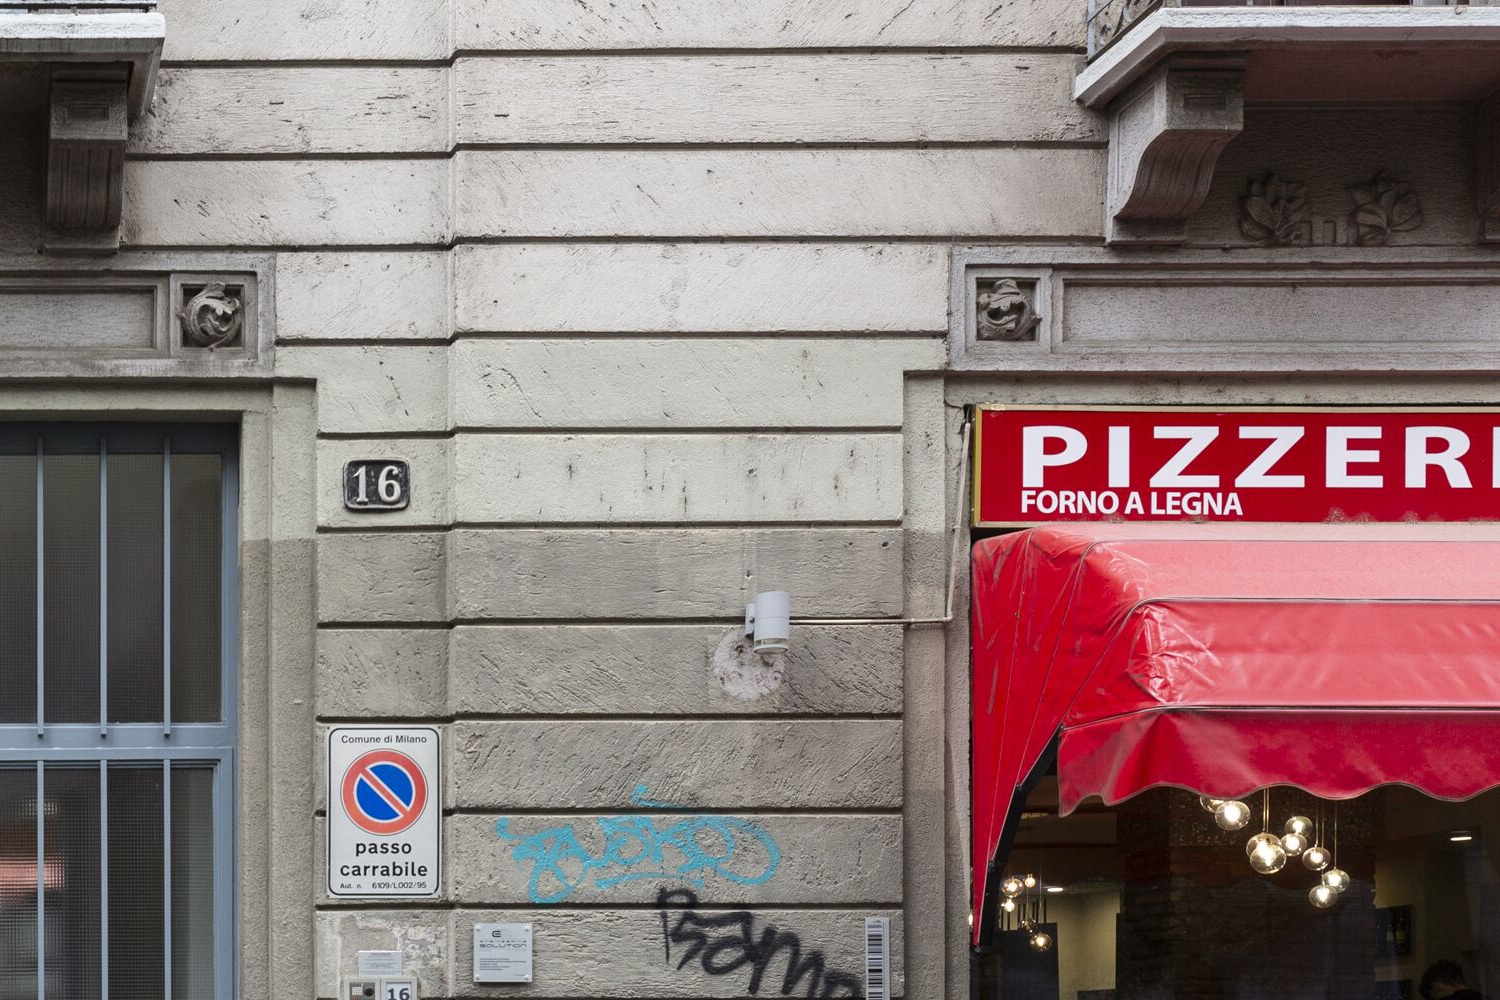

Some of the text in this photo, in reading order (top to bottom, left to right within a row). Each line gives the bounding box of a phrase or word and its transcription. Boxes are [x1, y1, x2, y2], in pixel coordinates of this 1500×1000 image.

[351, 465, 402, 503] 16
[1021, 490, 1243, 515] FORNO A LEGNA
[341, 735, 428, 744] Comune di Milano
[355, 842, 412, 857] passo
[340, 861, 428, 877] carrabile
